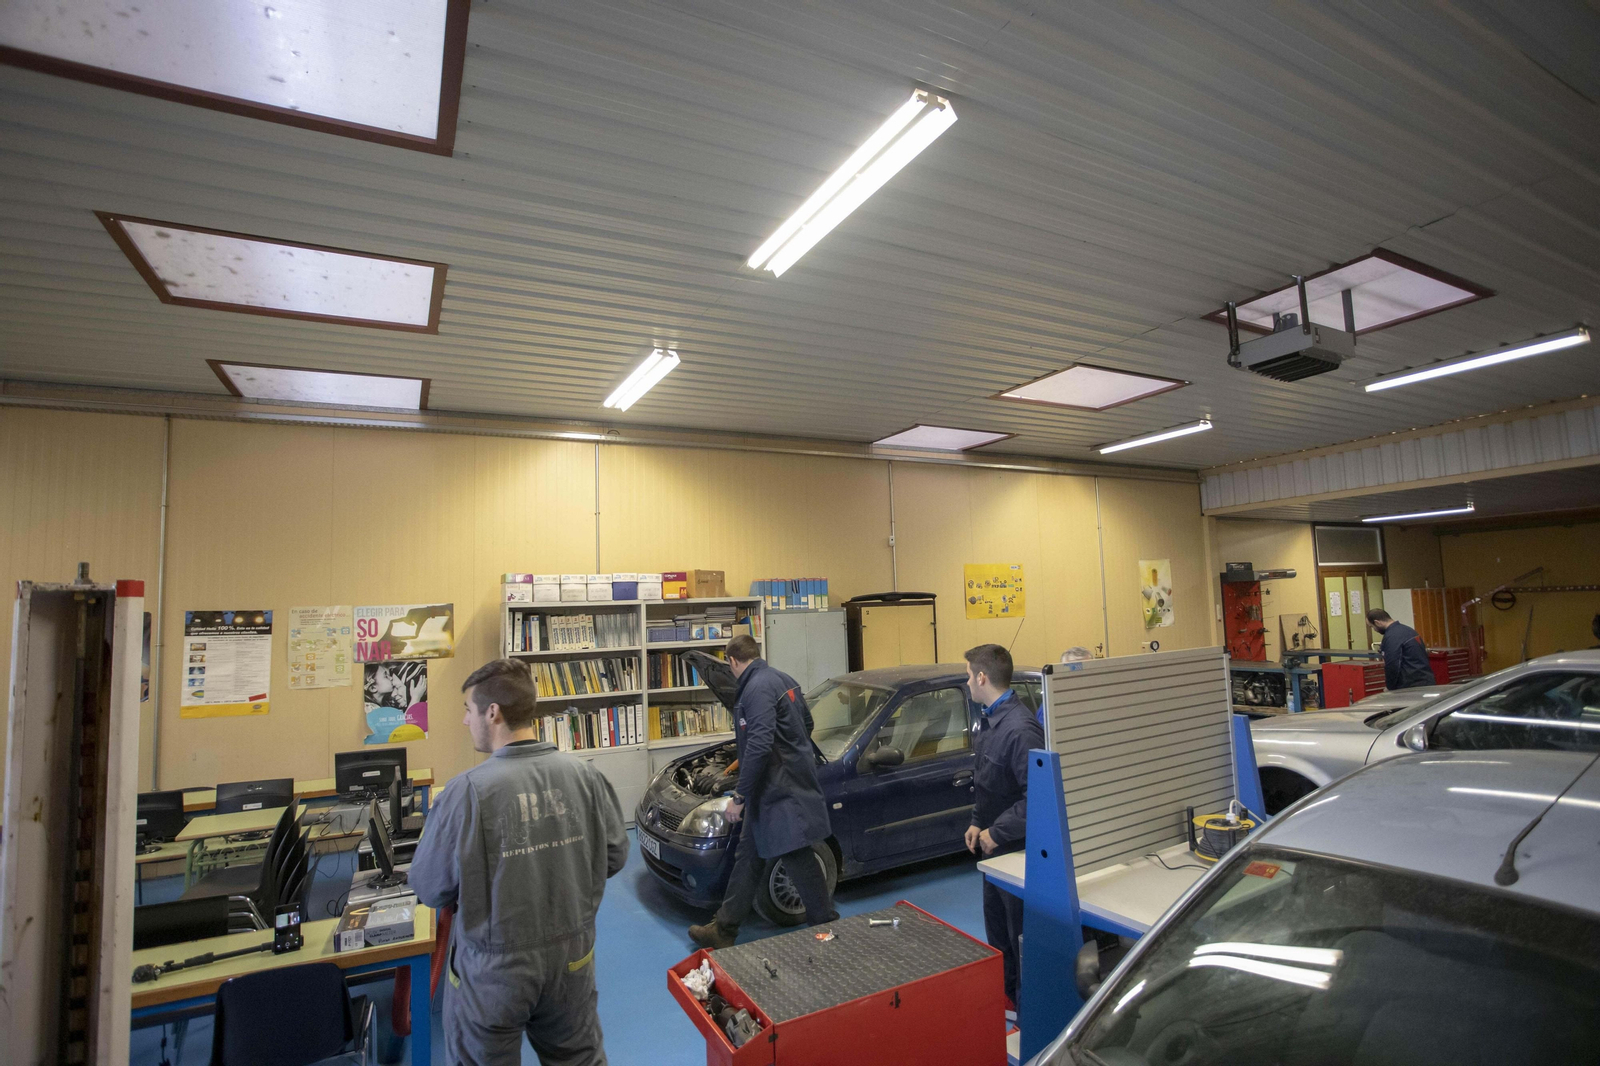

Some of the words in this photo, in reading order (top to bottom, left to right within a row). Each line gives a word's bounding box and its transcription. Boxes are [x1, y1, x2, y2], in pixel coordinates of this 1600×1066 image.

[356, 607, 383, 617] ELEGIR
[385, 606, 405, 616] PARA
[356, 618, 379, 638] SO
[356, 638, 392, 661] ÑAR
